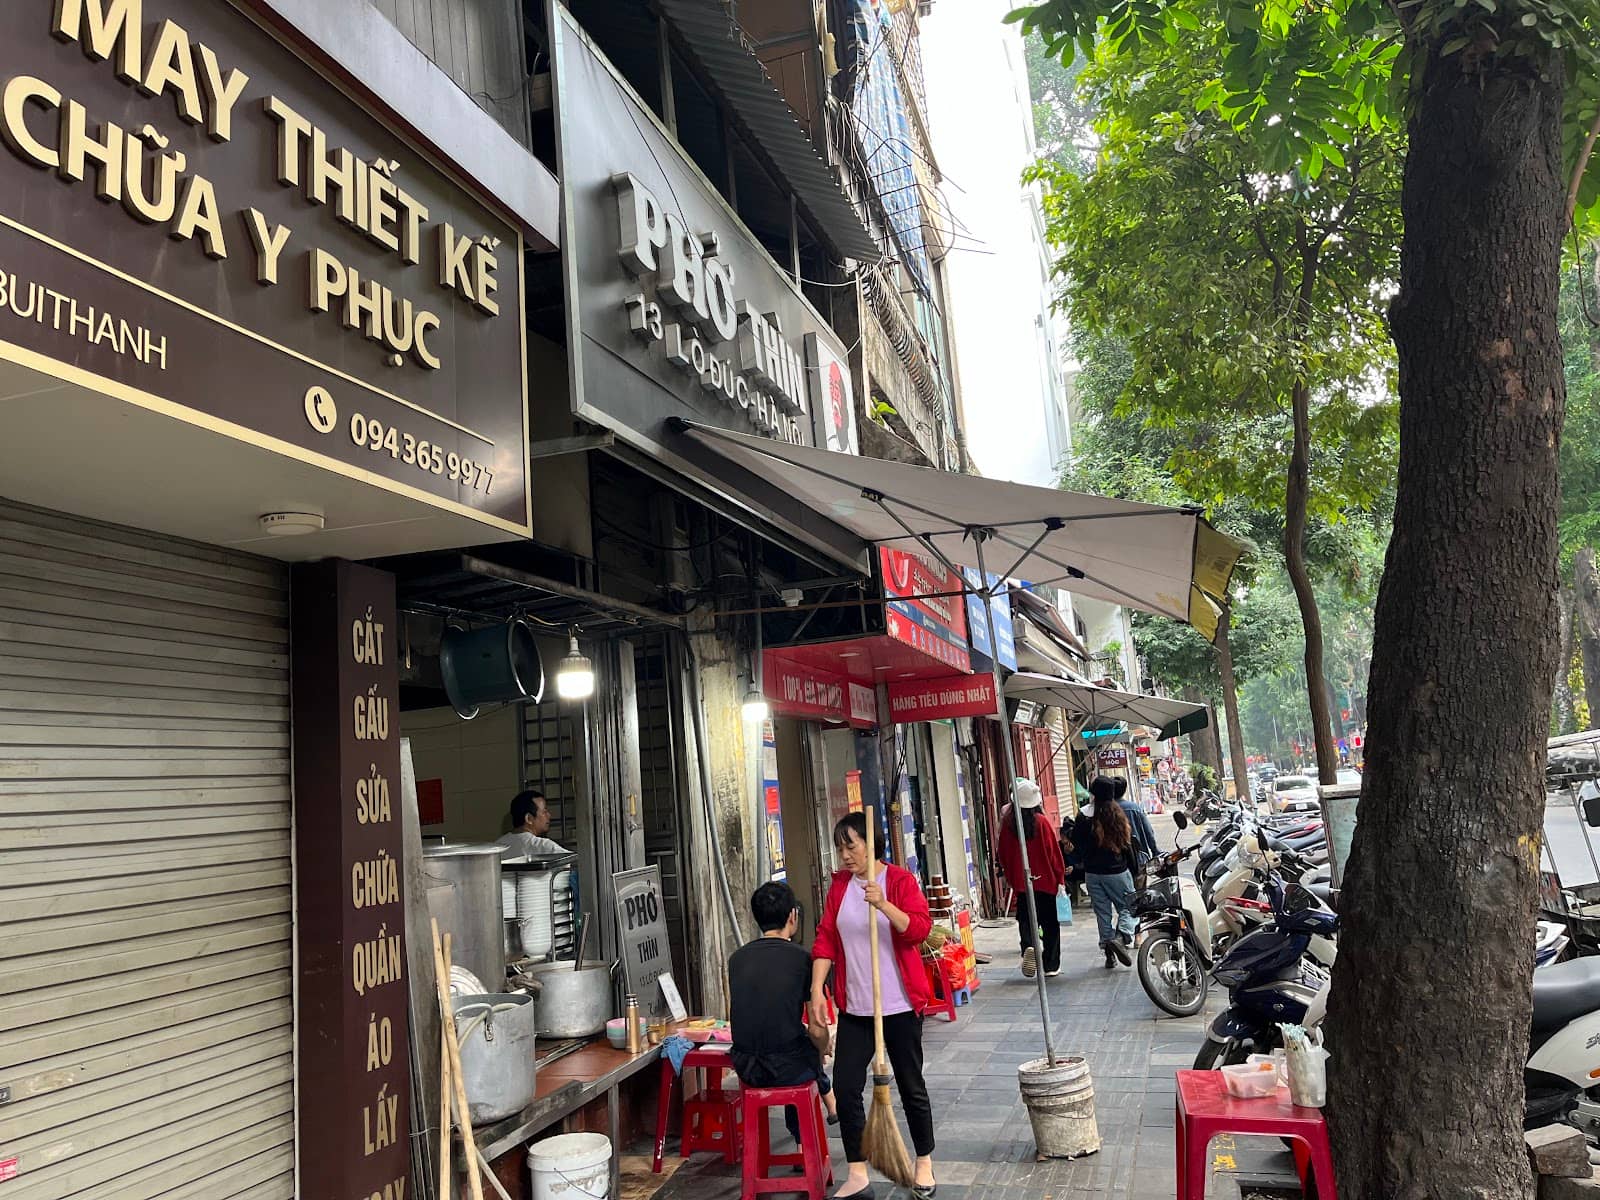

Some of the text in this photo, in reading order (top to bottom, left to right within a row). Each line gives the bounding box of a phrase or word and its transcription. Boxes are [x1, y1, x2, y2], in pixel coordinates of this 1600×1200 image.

[52, 0, 501, 318] MAY THIẾT KẾ
[2, 75, 441, 370] CHỮA Y PHỤC
[618, 172, 738, 342] PHỞ
[627, 293, 664, 341] 13
[666, 325, 705, 375] LÒ
[738, 299, 807, 416] THÌN
[350, 413, 498, 496] 094 365 9977
[352, 606, 385, 666] CẮT
[353, 684, 389, 742] GẤU
[892, 694, 917, 711] HÀNG
[919, 690, 939, 708] TIÊU
[940, 688, 965, 706] DÙNG
[966, 685, 991, 704] NHẬT
[1098, 749, 1126, 759] CAFE
[355, 763, 392, 824] SỬA
[351, 849, 400, 910] CHỮA
[624, 880, 659, 930] PHỞ
[352, 922, 402, 997] QUẦN
[637, 935, 659, 963] THÌN
[366, 1016, 393, 1073] ÁO
[363, 1083, 399, 1156] LẤY
